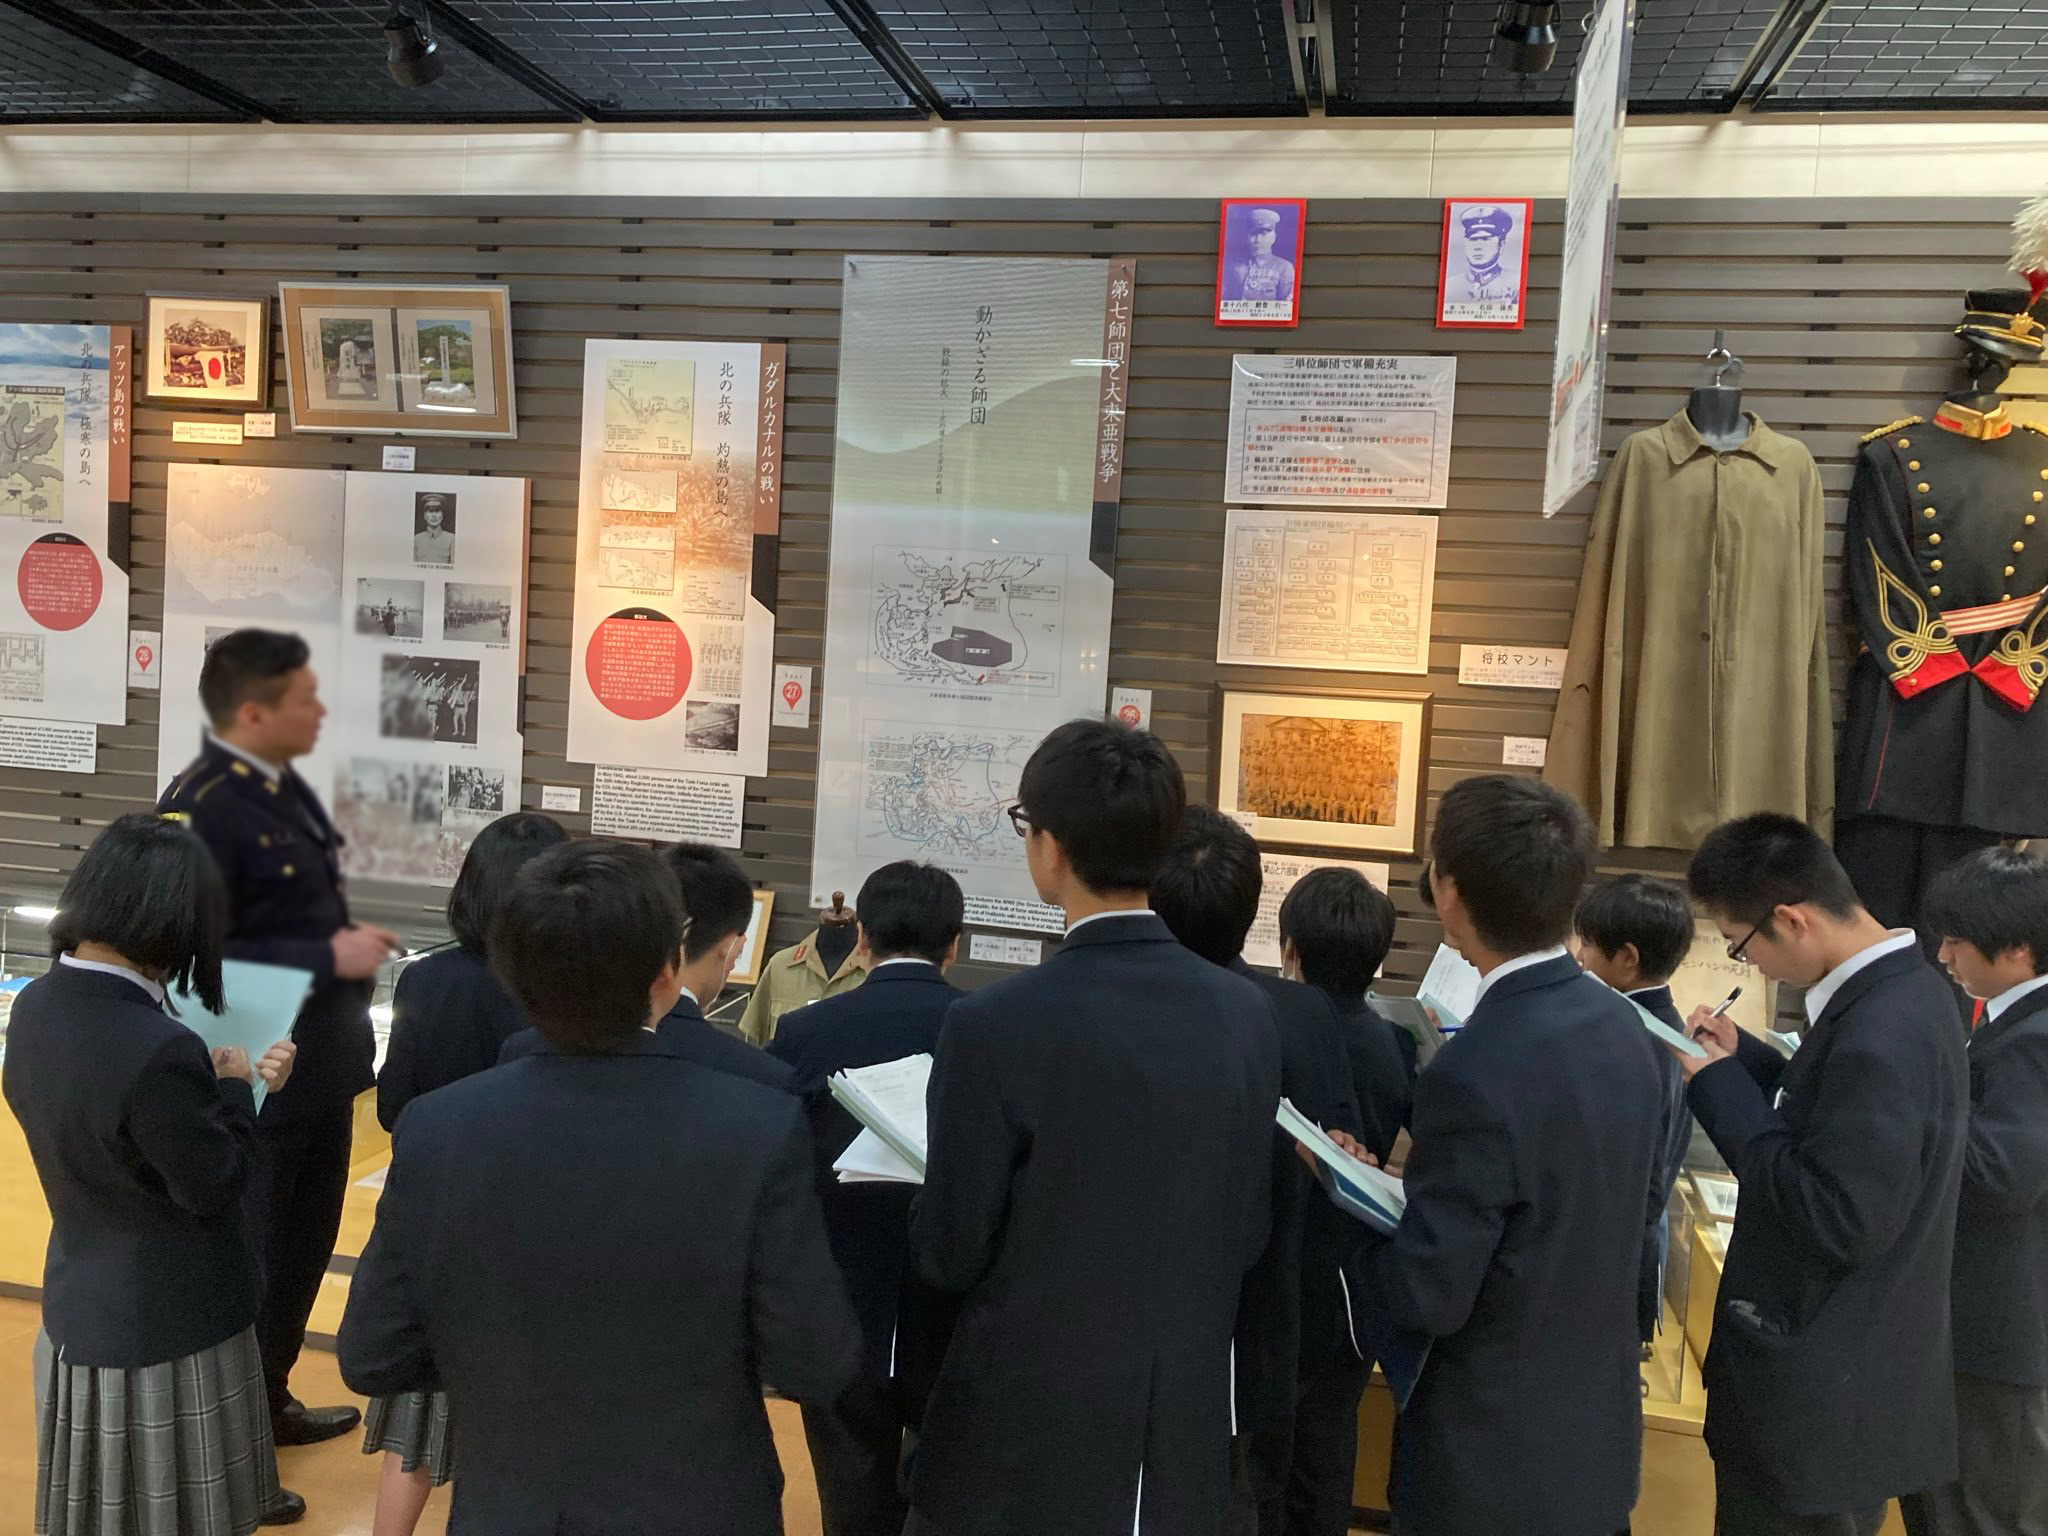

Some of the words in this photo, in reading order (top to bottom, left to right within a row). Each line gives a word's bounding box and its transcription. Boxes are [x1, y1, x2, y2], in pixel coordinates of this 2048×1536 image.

[80, 342, 93, 401] 北の兵隊
[112, 344, 126, 445] アッツ島の戦い
[717, 362, 734, 426] 北の兵隊
[970, 305, 993, 425] 動かざる師団
[1098, 279, 1129, 484] 第七師団と大東亜戦争
[79, 416, 92, 487] 極寒の島へ
[759, 362, 779, 504] ガダルカナルの戦い
[714, 443, 731, 519] 灼熱の島へ
[786, 685, 799, 698] 27
[1482, 652, 1553, 667] 将校マント
